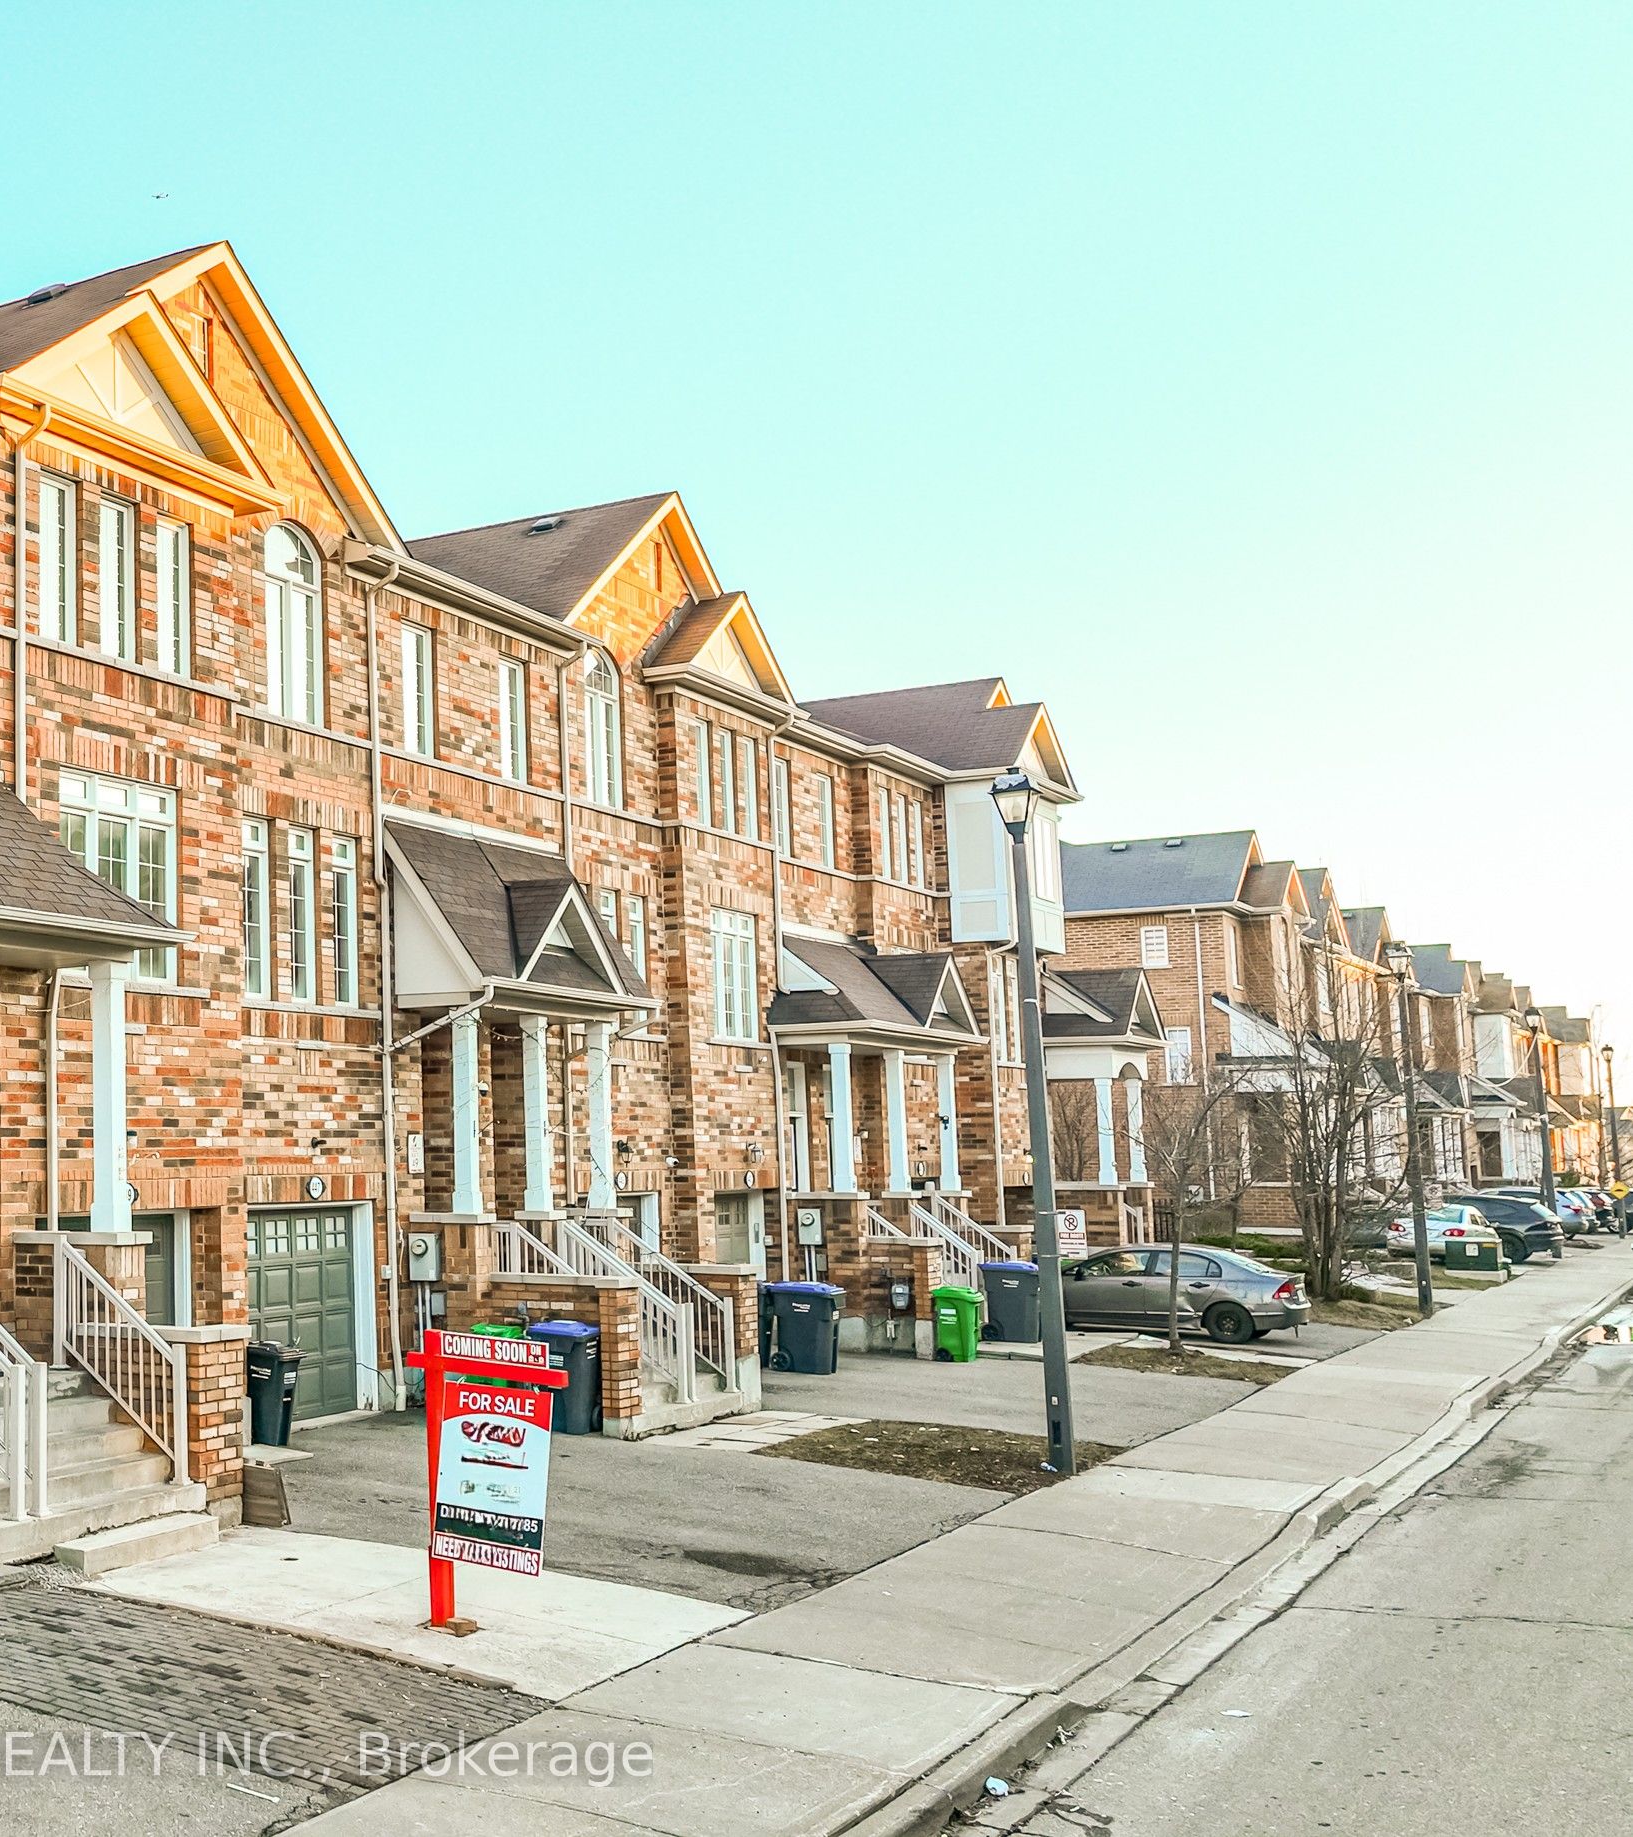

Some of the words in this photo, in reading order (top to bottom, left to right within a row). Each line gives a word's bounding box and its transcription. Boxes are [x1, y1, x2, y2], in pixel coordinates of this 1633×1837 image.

[444, 1335, 492, 1358] COMING
[494, 1341, 527, 1363] SOON
[459, 1391, 492, 1411] FOR
[493, 1395, 535, 1417] SALE
[435, 1535, 461, 1559] NEED
